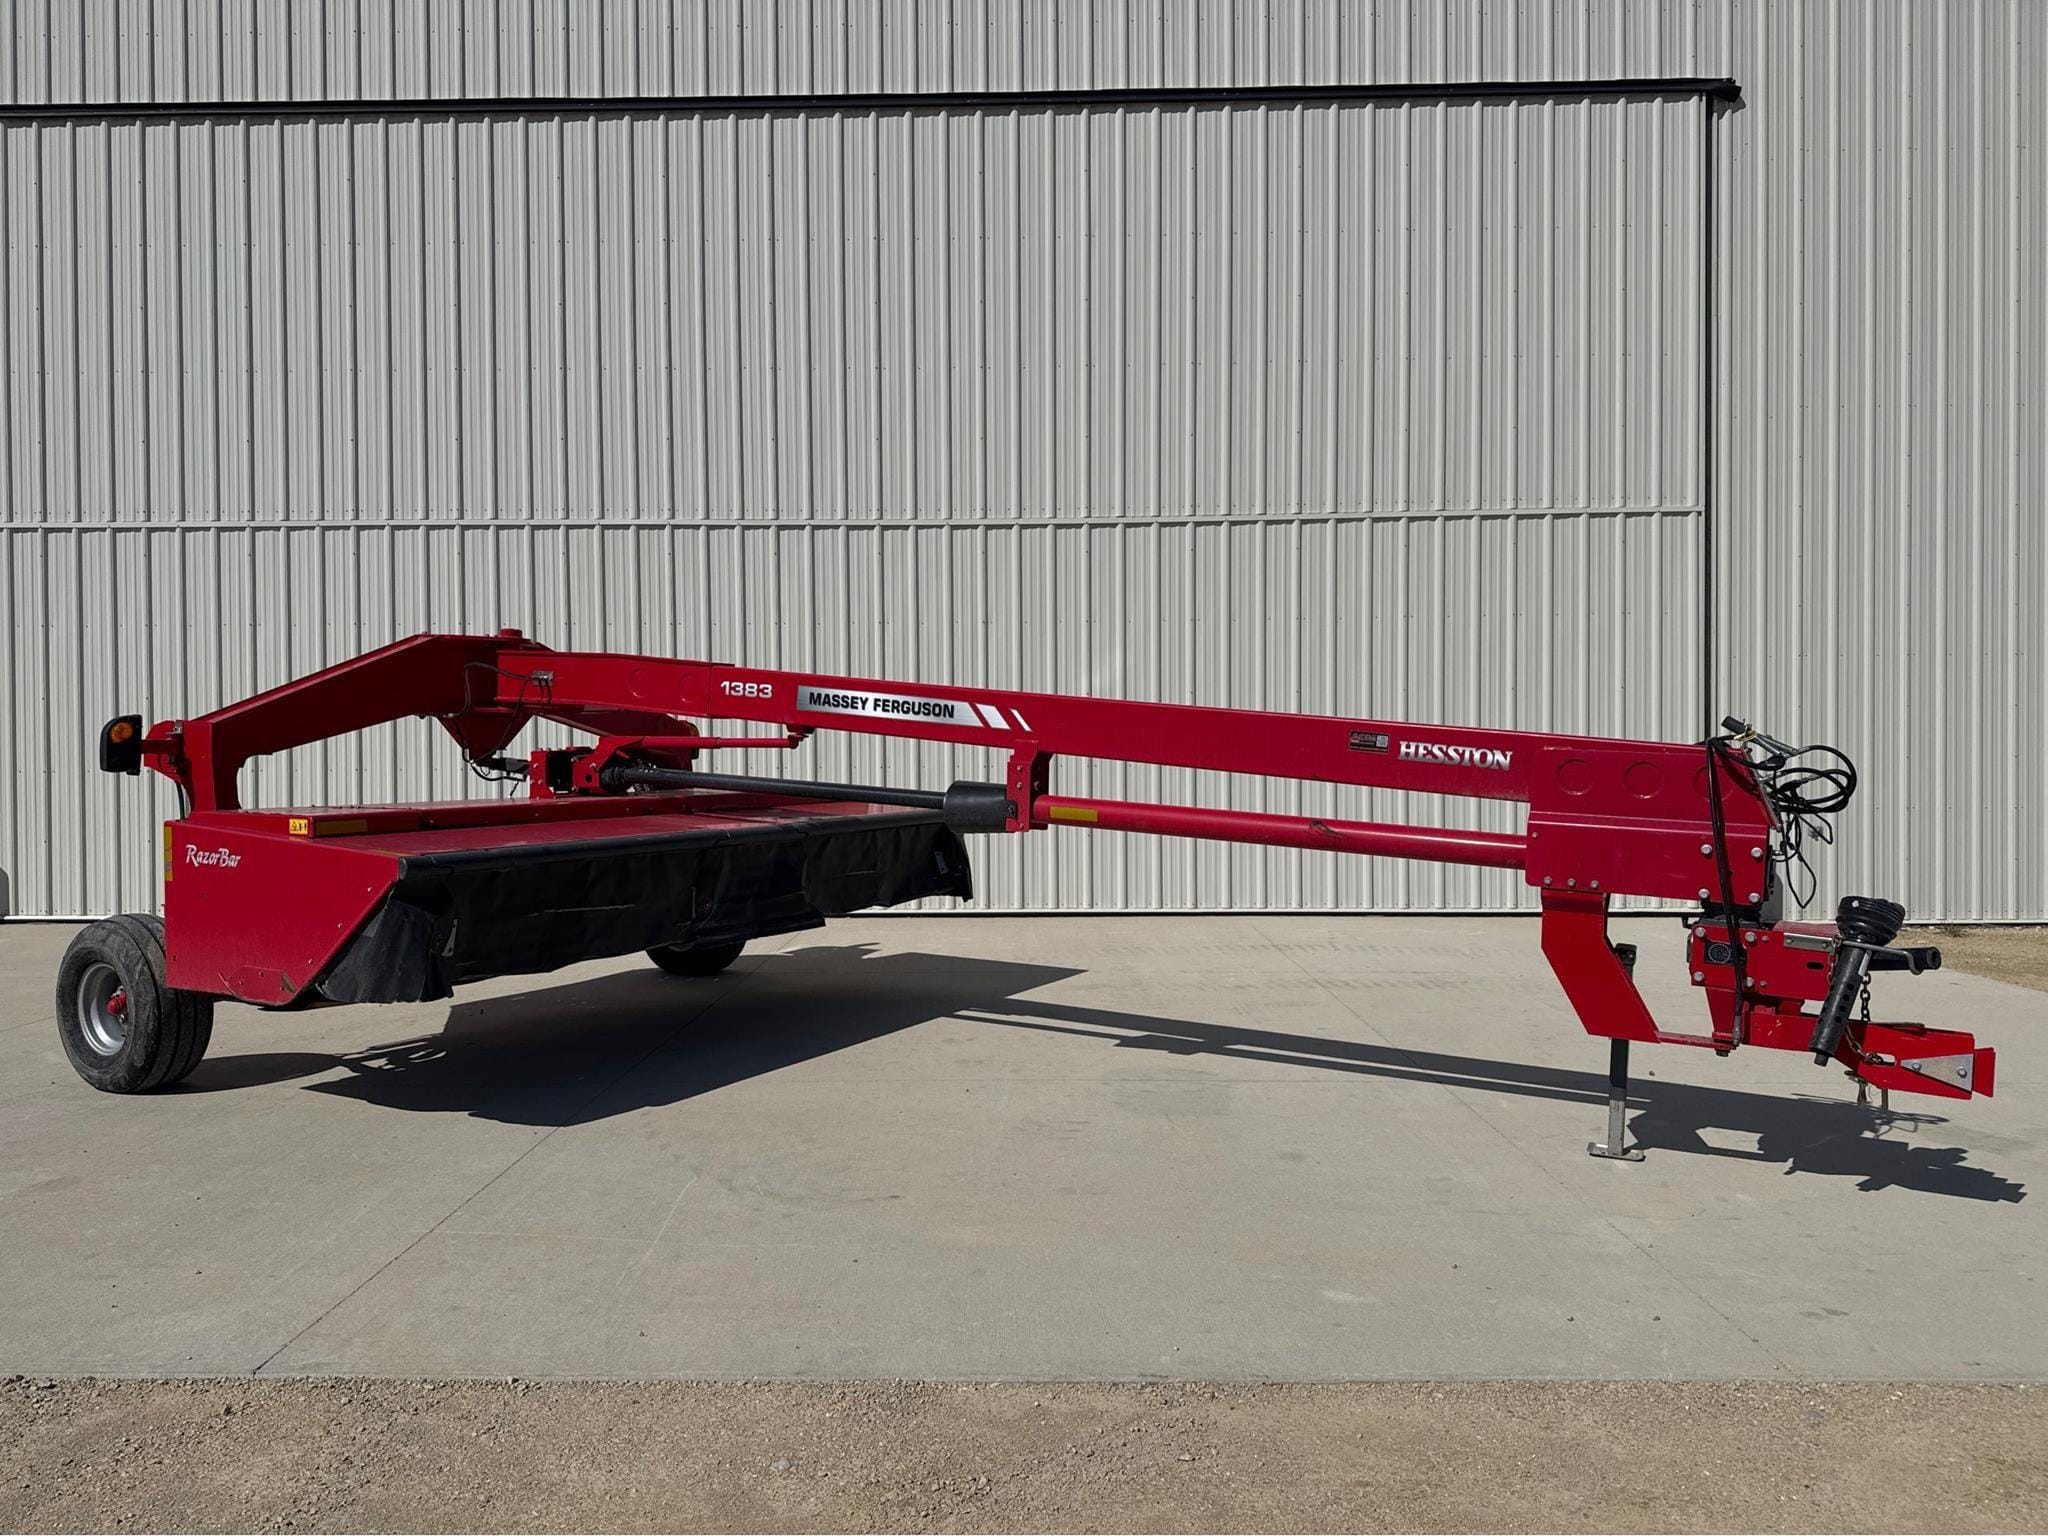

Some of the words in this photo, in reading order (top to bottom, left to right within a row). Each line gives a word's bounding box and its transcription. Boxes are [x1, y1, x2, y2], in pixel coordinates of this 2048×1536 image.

[720, 681, 772, 698] 1383
[809, 692, 868, 710] MASSEY
[873, 698, 955, 718] FERGUSON
[1399, 741, 1512, 770] HESSTON
